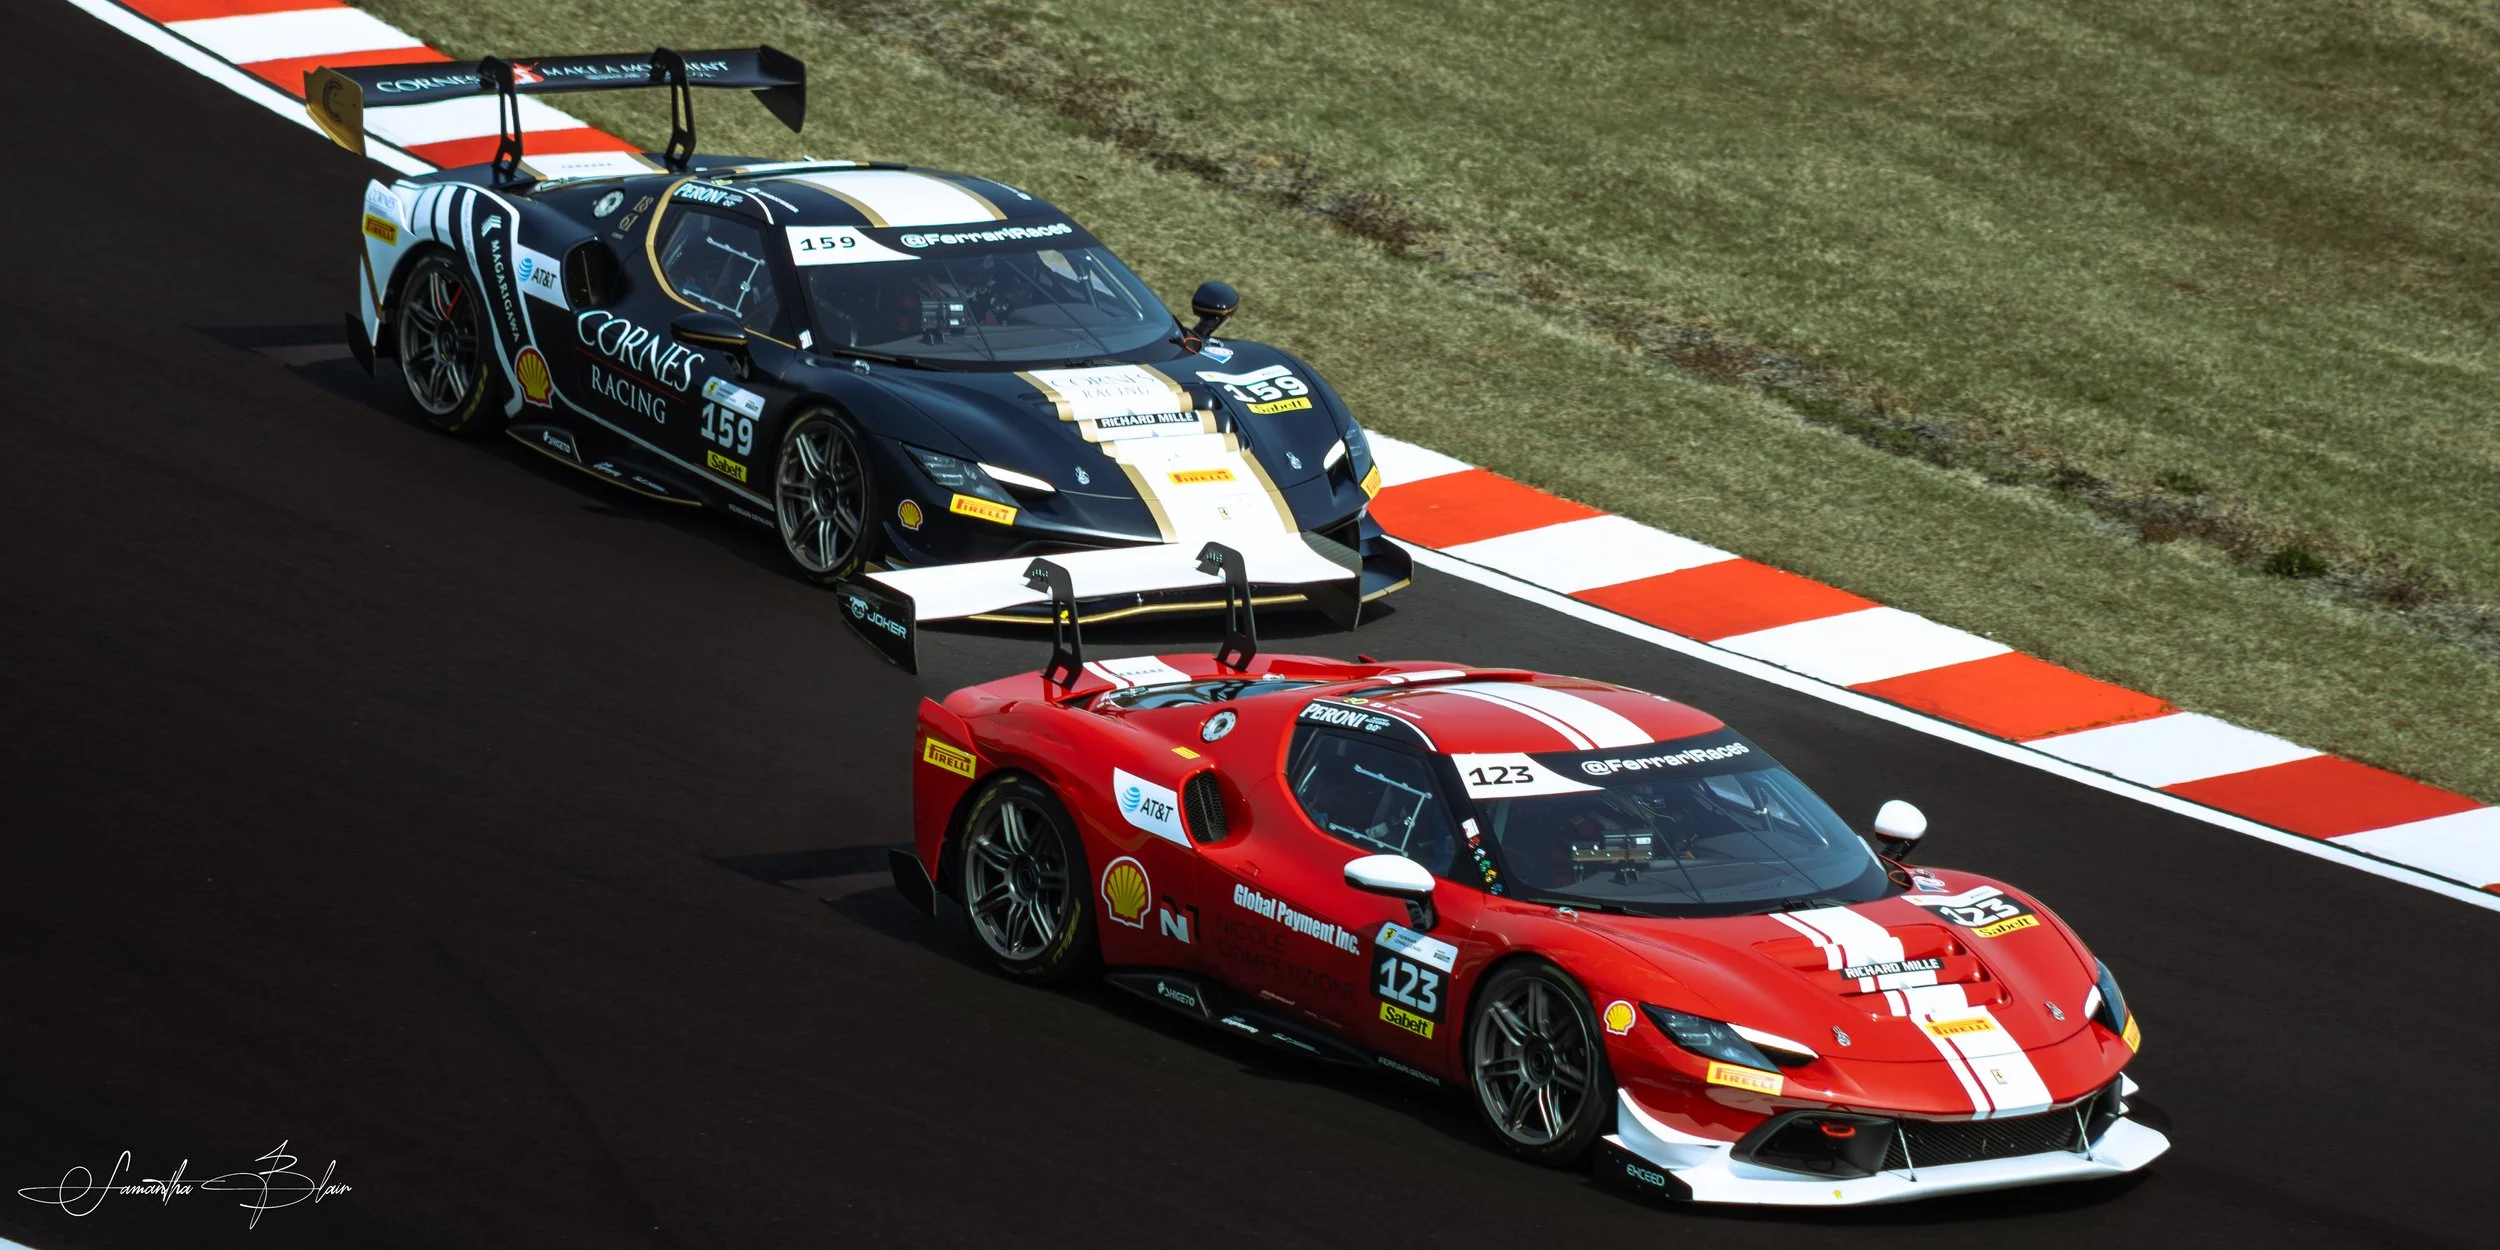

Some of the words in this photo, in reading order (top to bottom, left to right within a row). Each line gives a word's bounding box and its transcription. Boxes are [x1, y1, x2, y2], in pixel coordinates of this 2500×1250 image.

[541, 64, 602, 77] MAKE
[604, 63, 620, 74] A
[673, 183, 728, 204] PERONI
[800, 236, 856, 251] 159
[900, 222, 1073, 248] @FerrariRaces
[490, 239, 520, 343] MAGARIGAWA
[532, 267, 558, 290] AT&T
[577, 310, 706, 393] CORNES
[591, 364, 666, 424] RACING
[1223, 375, 1309, 403] 159
[701, 402, 753, 456] 159
[1102, 412, 1156, 428] RICHARD
[1157, 411, 1194, 423] MILLE
[711, 454, 744, 480] Sabelt
[1173, 470, 1231, 483] PIRELLI
[957, 498, 1009, 521] PIRELLI
[867, 612, 907, 640] JOKER
[1299, 702, 1369, 729] PERONI
[928, 743, 972, 774] PIRELLI
[1581, 742, 1750, 776] @FerrariRaces
[1468, 765, 1535, 786] 123
[1139, 797, 1174, 823] AT&T
[1233, 883, 1277, 921] Global
[1277, 900, 1335, 945] Payment
[1335, 925, 1361, 957] Inc.
[1939, 897, 2020, 927] 123
[1978, 917, 2031, 937] Sabelt
[1844, 963, 1901, 979] RICHARD
[1902, 957, 1940, 972] MILLE
[1163, 986, 1196, 1008] SHIGETO
[1379, 956, 1440, 1014] 123
[1384, 1006, 1429, 1036] Sabelt
[1931, 1019, 1990, 1035] PIRELLI
[1715, 1067, 1775, 1090] PIRELLI
[1626, 1163, 1666, 1187] EXCEED
